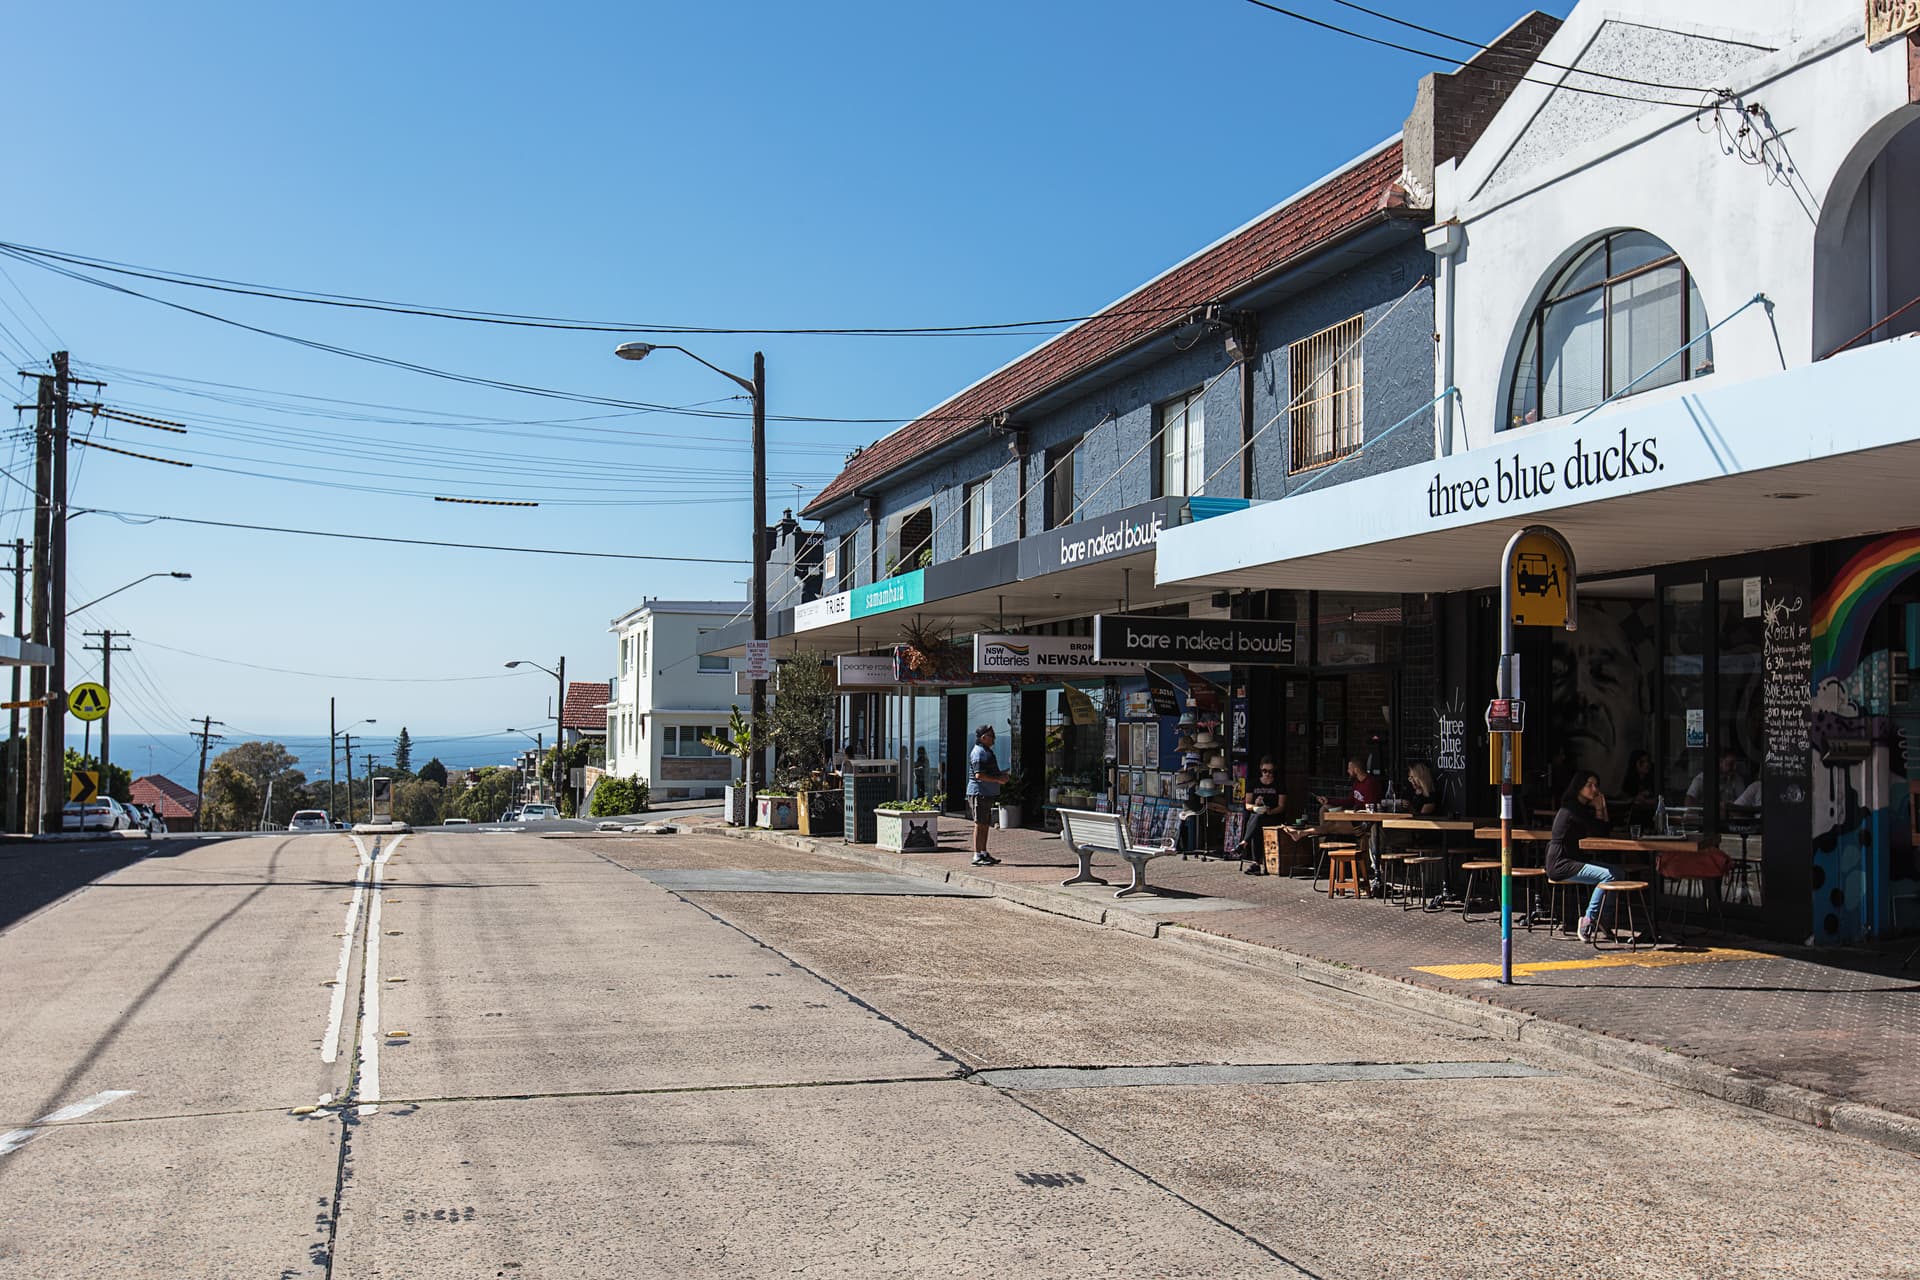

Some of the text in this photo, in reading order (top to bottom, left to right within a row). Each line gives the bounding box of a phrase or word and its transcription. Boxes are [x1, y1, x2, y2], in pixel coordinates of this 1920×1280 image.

[1427, 427, 1664, 518] three blue ducks.
[1060, 511, 1163, 565] bare naked bowls
[825, 596, 845, 616] TRIBE
[1127, 627, 1292, 652] bare naked bowls
[1774, 621, 1796, 641] OPEN
[843, 663, 874, 673] peache
[984, 654, 1030, 667] Lotteries
[1439, 715, 1465, 736] three
[1440, 732, 1462, 754] blue
[1437, 750, 1466, 769] ducks
